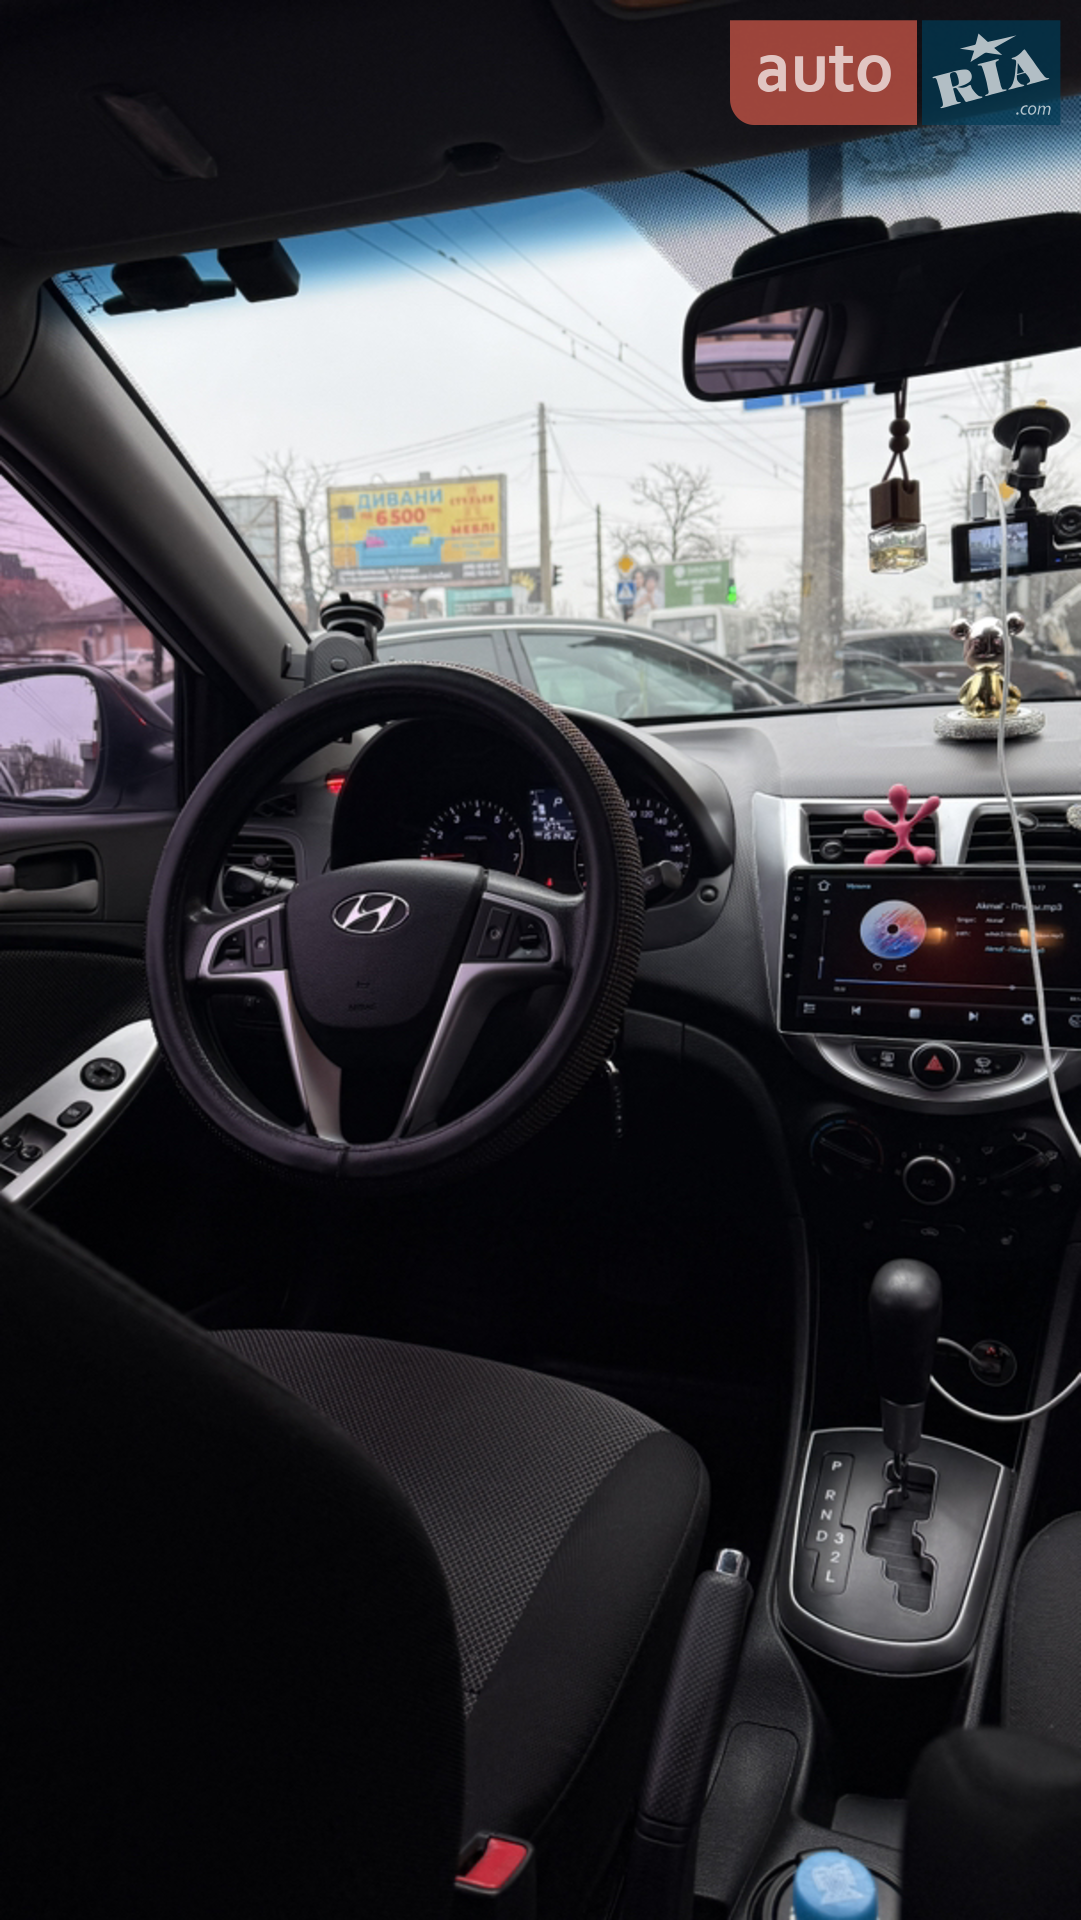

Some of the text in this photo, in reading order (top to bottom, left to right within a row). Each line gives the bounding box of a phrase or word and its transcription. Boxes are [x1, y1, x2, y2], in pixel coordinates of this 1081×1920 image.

[357, 488, 442, 511] ДИВАНИ
[473, 808, 482, 818] 4
[452, 814, 461, 824] 3
[436, 830, 444, 840] 2
[831, 1461, 842, 1471] P
[825, 1490, 836, 1500] R
[820, 1510, 833, 1520] N
[816, 1530, 845, 1544] D 3
[830, 1552, 840, 1563] 2
[825, 1570, 835, 1583] L
